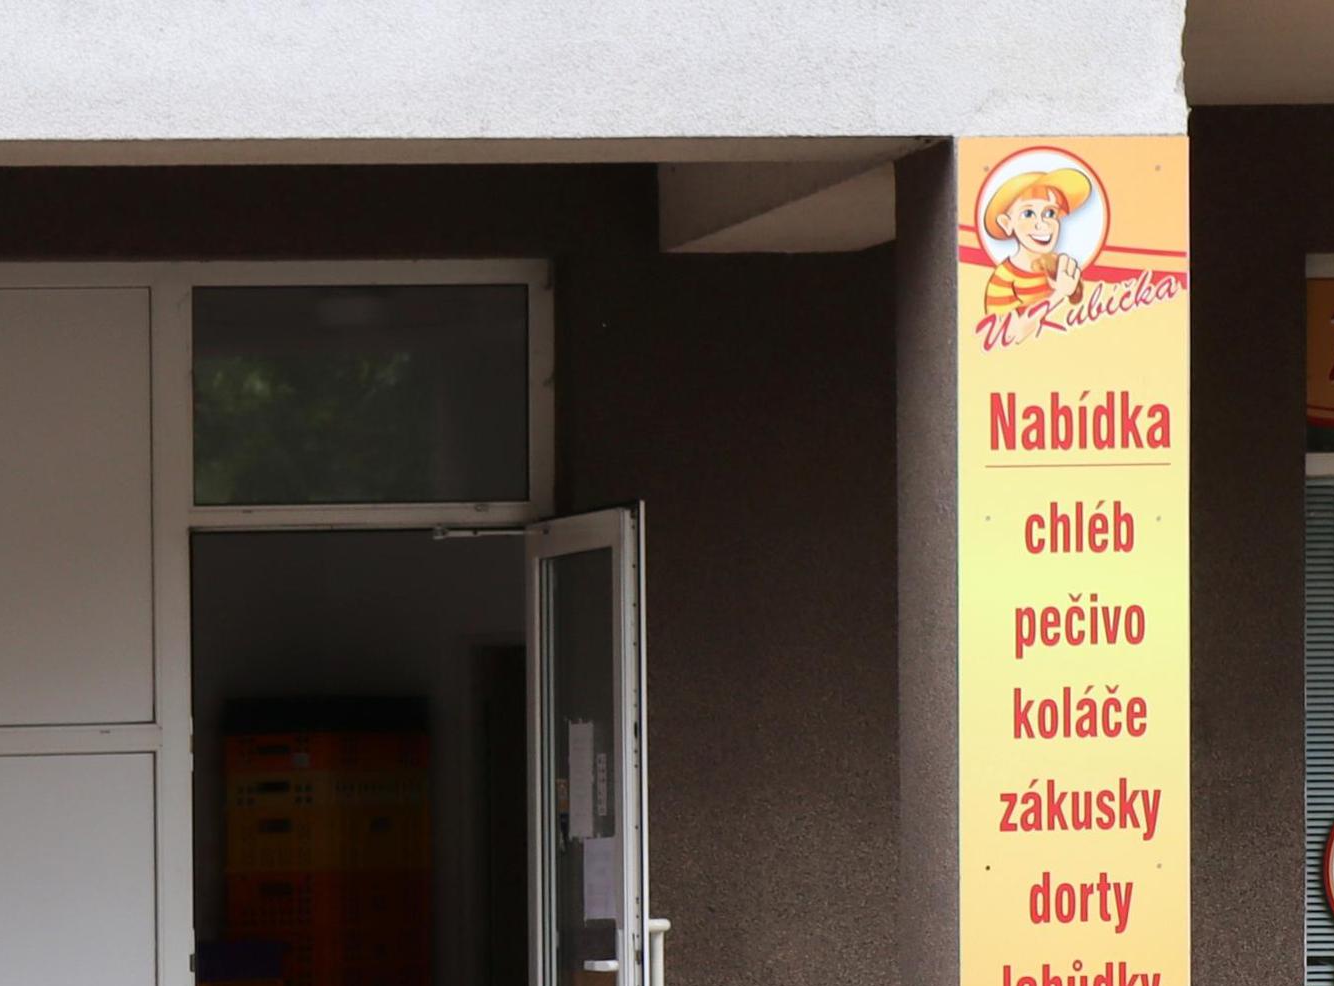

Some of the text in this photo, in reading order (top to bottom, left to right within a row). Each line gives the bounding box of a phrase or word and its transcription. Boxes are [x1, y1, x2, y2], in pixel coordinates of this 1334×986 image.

[975, 270, 1179, 352] U Kubíčka
[989, 390, 1171, 451] Nabídka
[1024, 500, 1135, 555] chléb
[1015, 593, 1145, 660] pečivo
[1013, 685, 1147, 740] koláče
[999, 777, 1161, 841] zákusky
[1029, 871, 1133, 934] dorty
